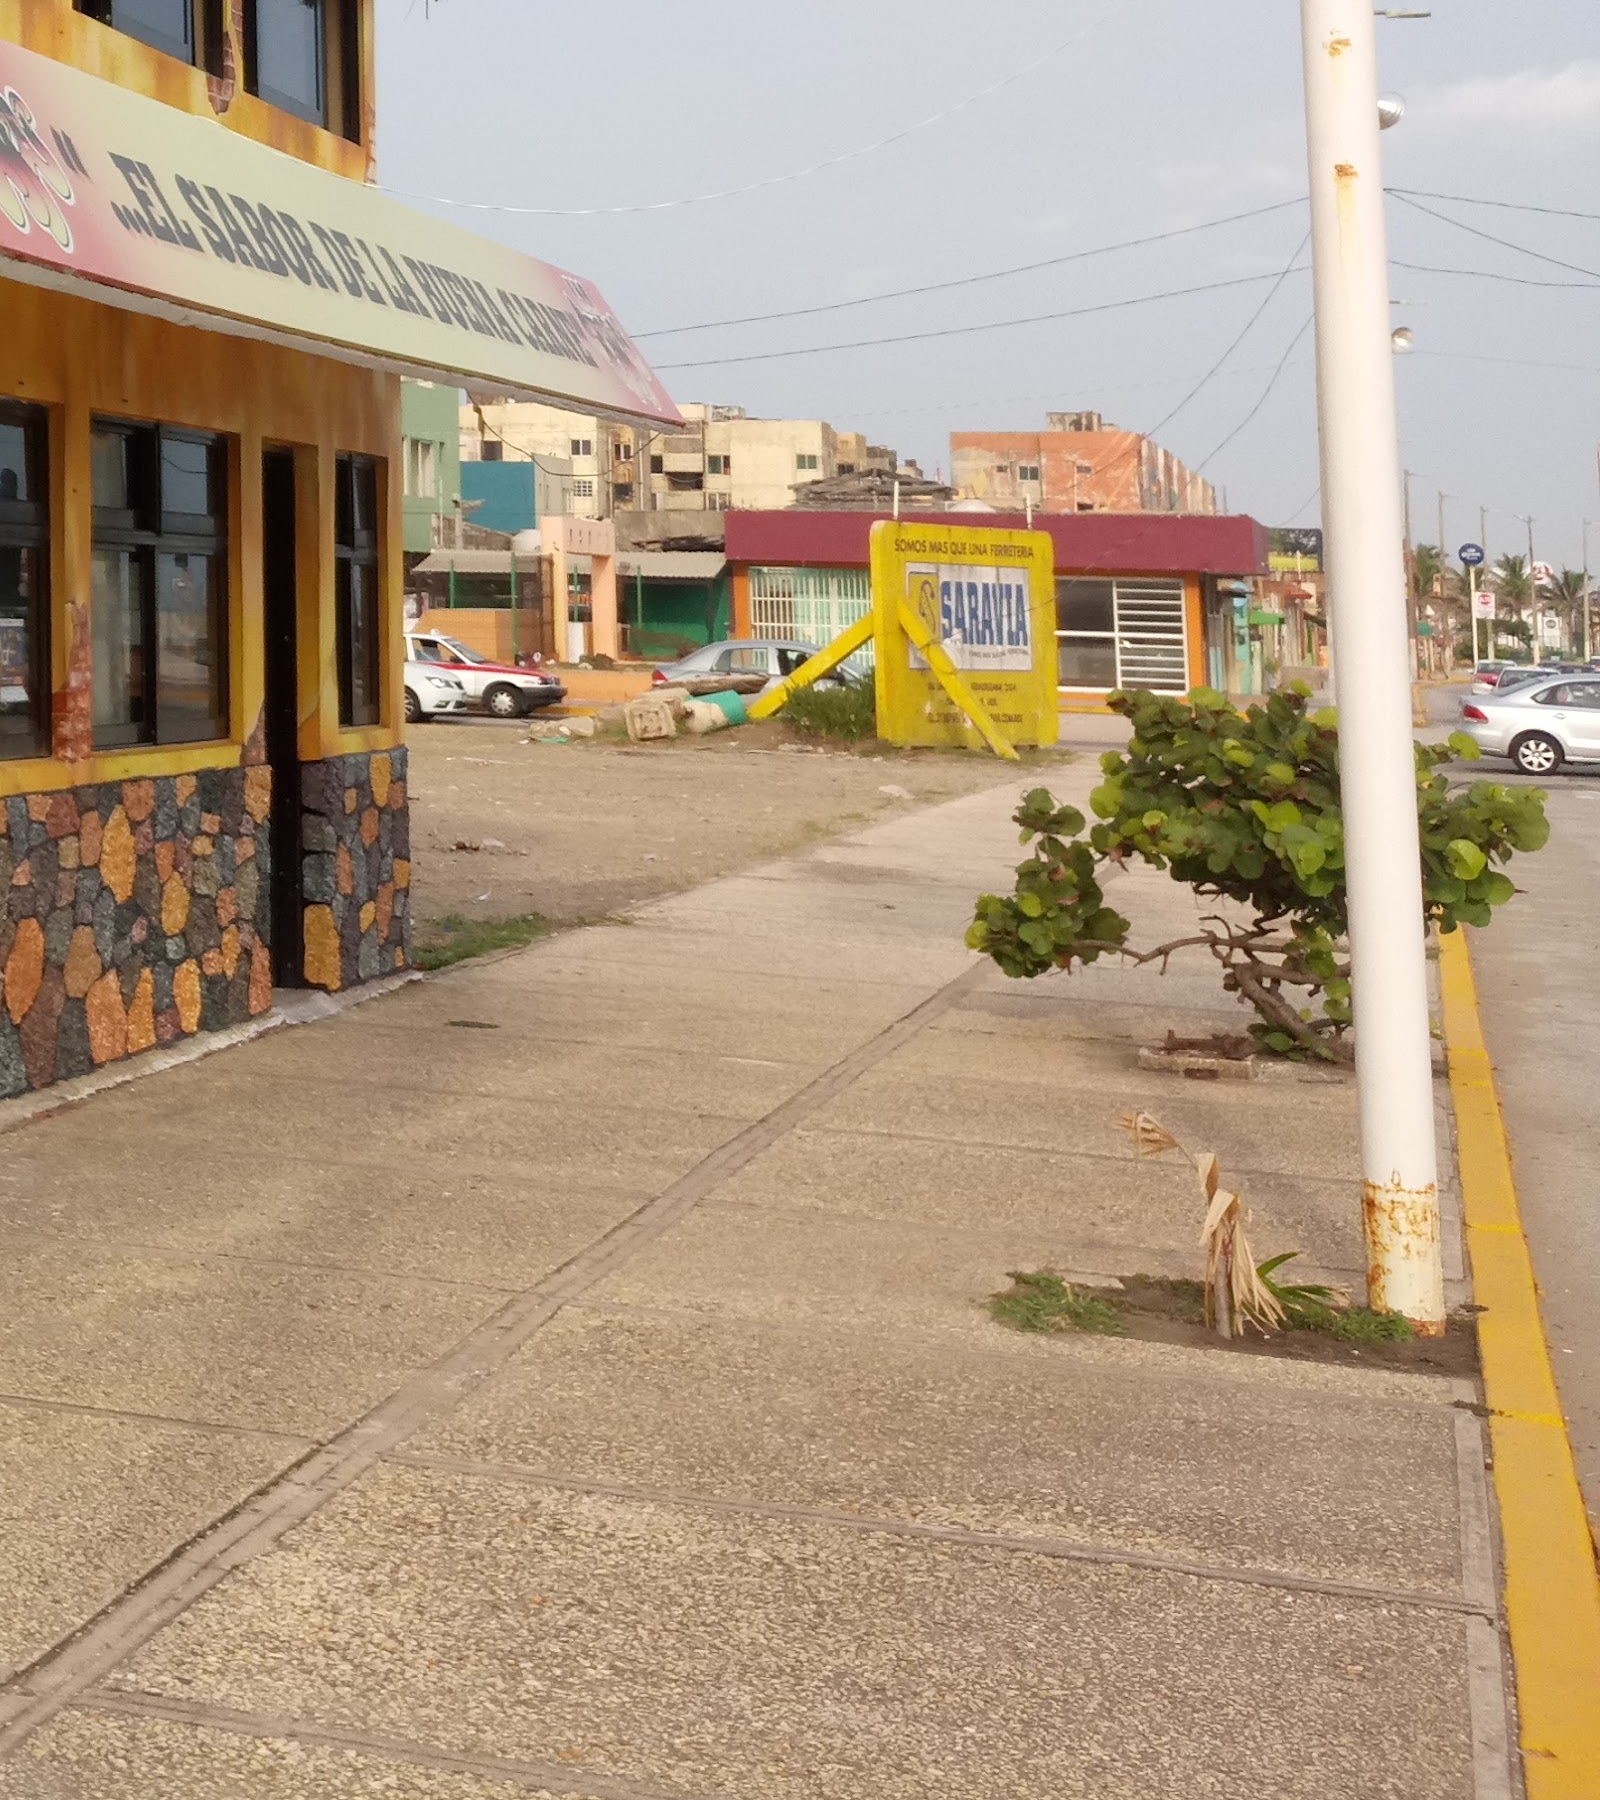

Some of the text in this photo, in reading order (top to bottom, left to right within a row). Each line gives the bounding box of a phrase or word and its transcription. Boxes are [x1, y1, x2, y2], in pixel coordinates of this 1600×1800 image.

[175, 173, 339, 293] SABOR
[307, 220, 387, 306] DE
[355, 236, 433, 319] LA
[400, 253, 524, 346] BUENA
[496, 287, 599, 368] CARNE
[894, 538, 926, 553] SOMOS
[929, 541, 948, 554] MAS
[950, 541, 967, 555] QUE
